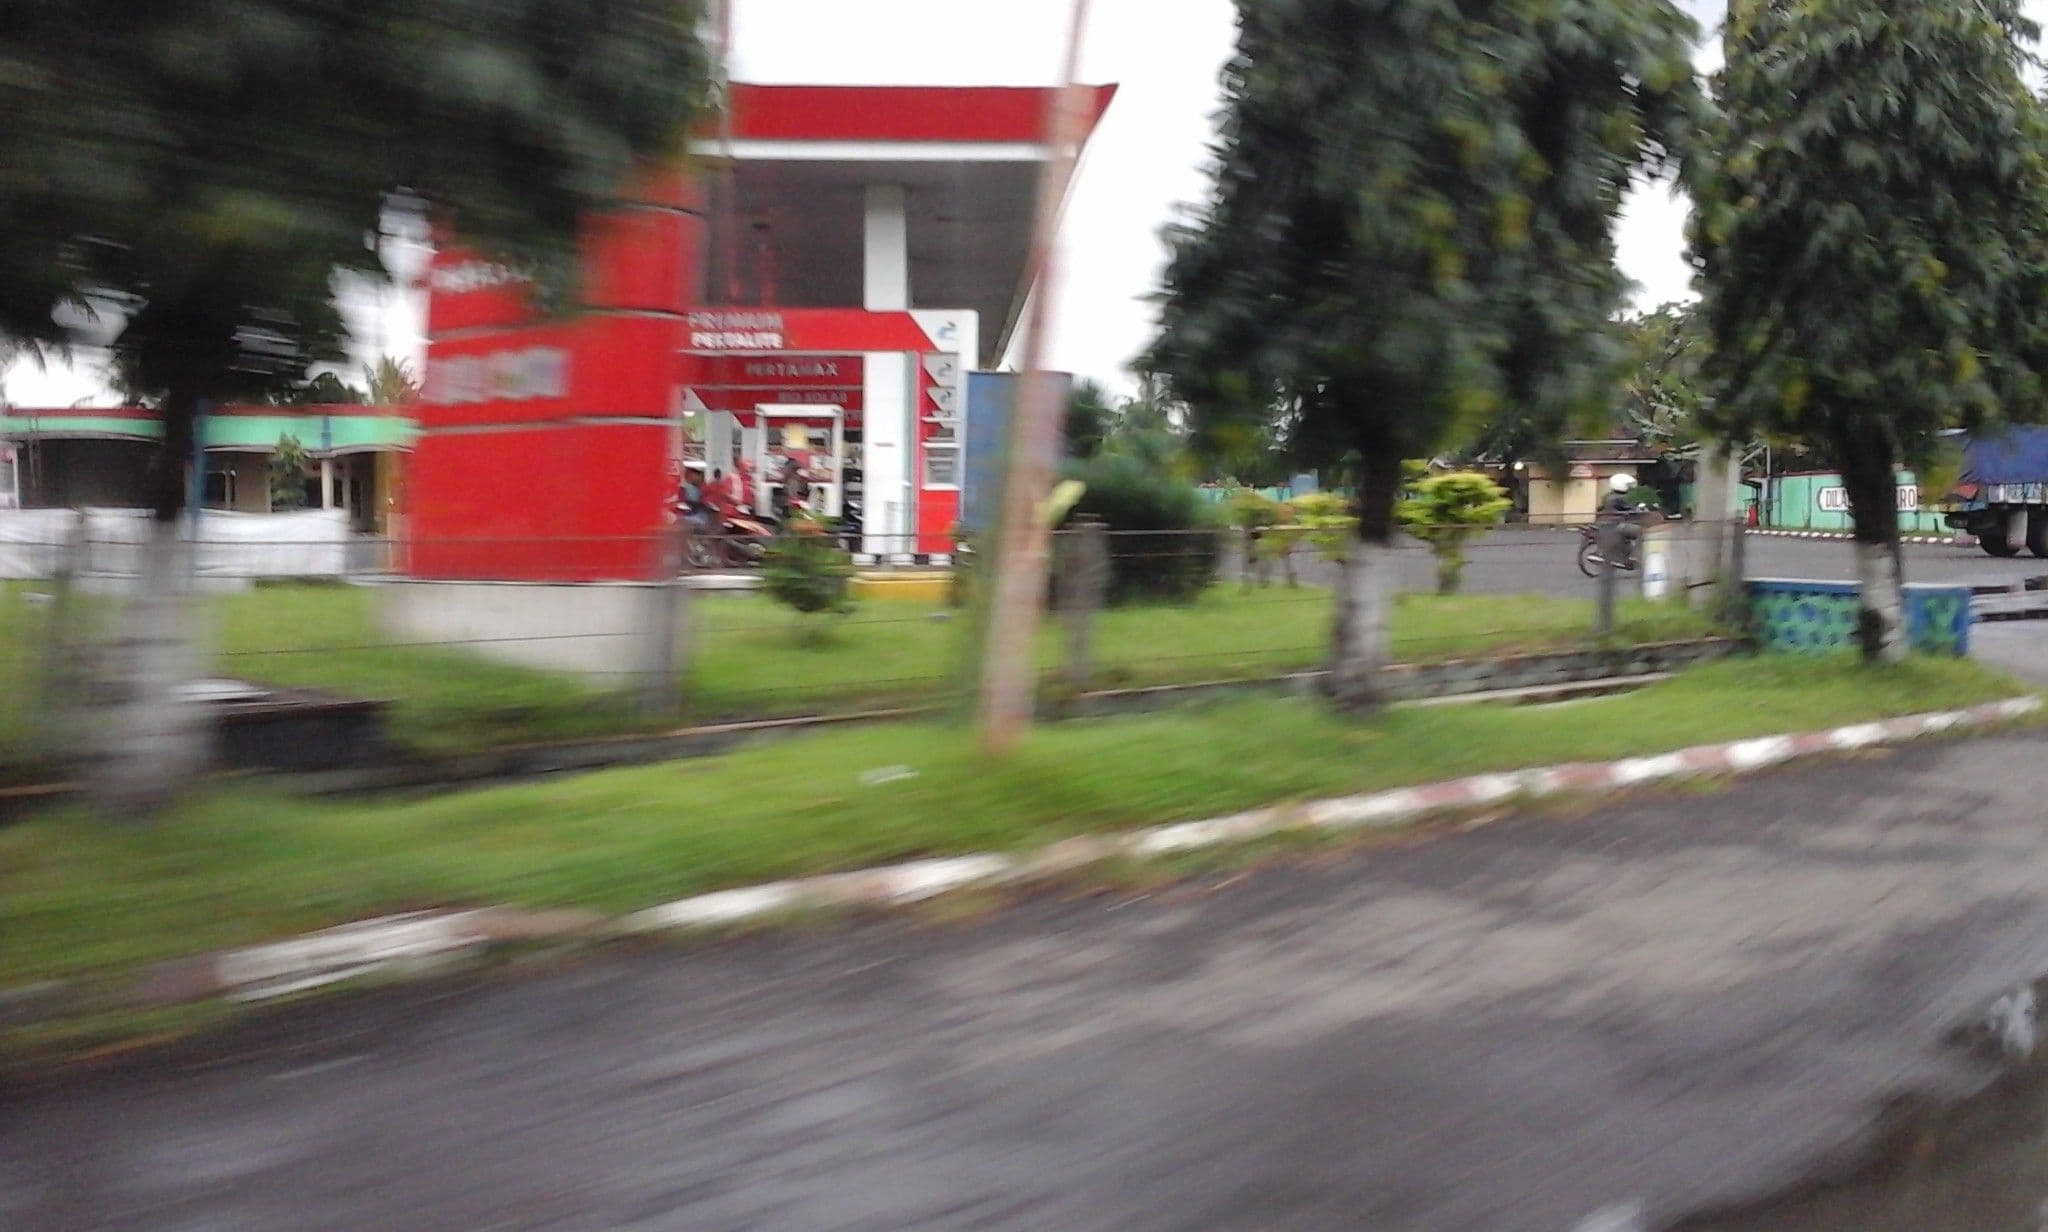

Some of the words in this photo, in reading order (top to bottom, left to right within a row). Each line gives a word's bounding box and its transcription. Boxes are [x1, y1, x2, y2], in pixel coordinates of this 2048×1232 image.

[691, 332, 783, 348] PERTALITE
[746, 363, 838, 377] PERTAMAX
[1825, 489, 1849, 508] DILA
